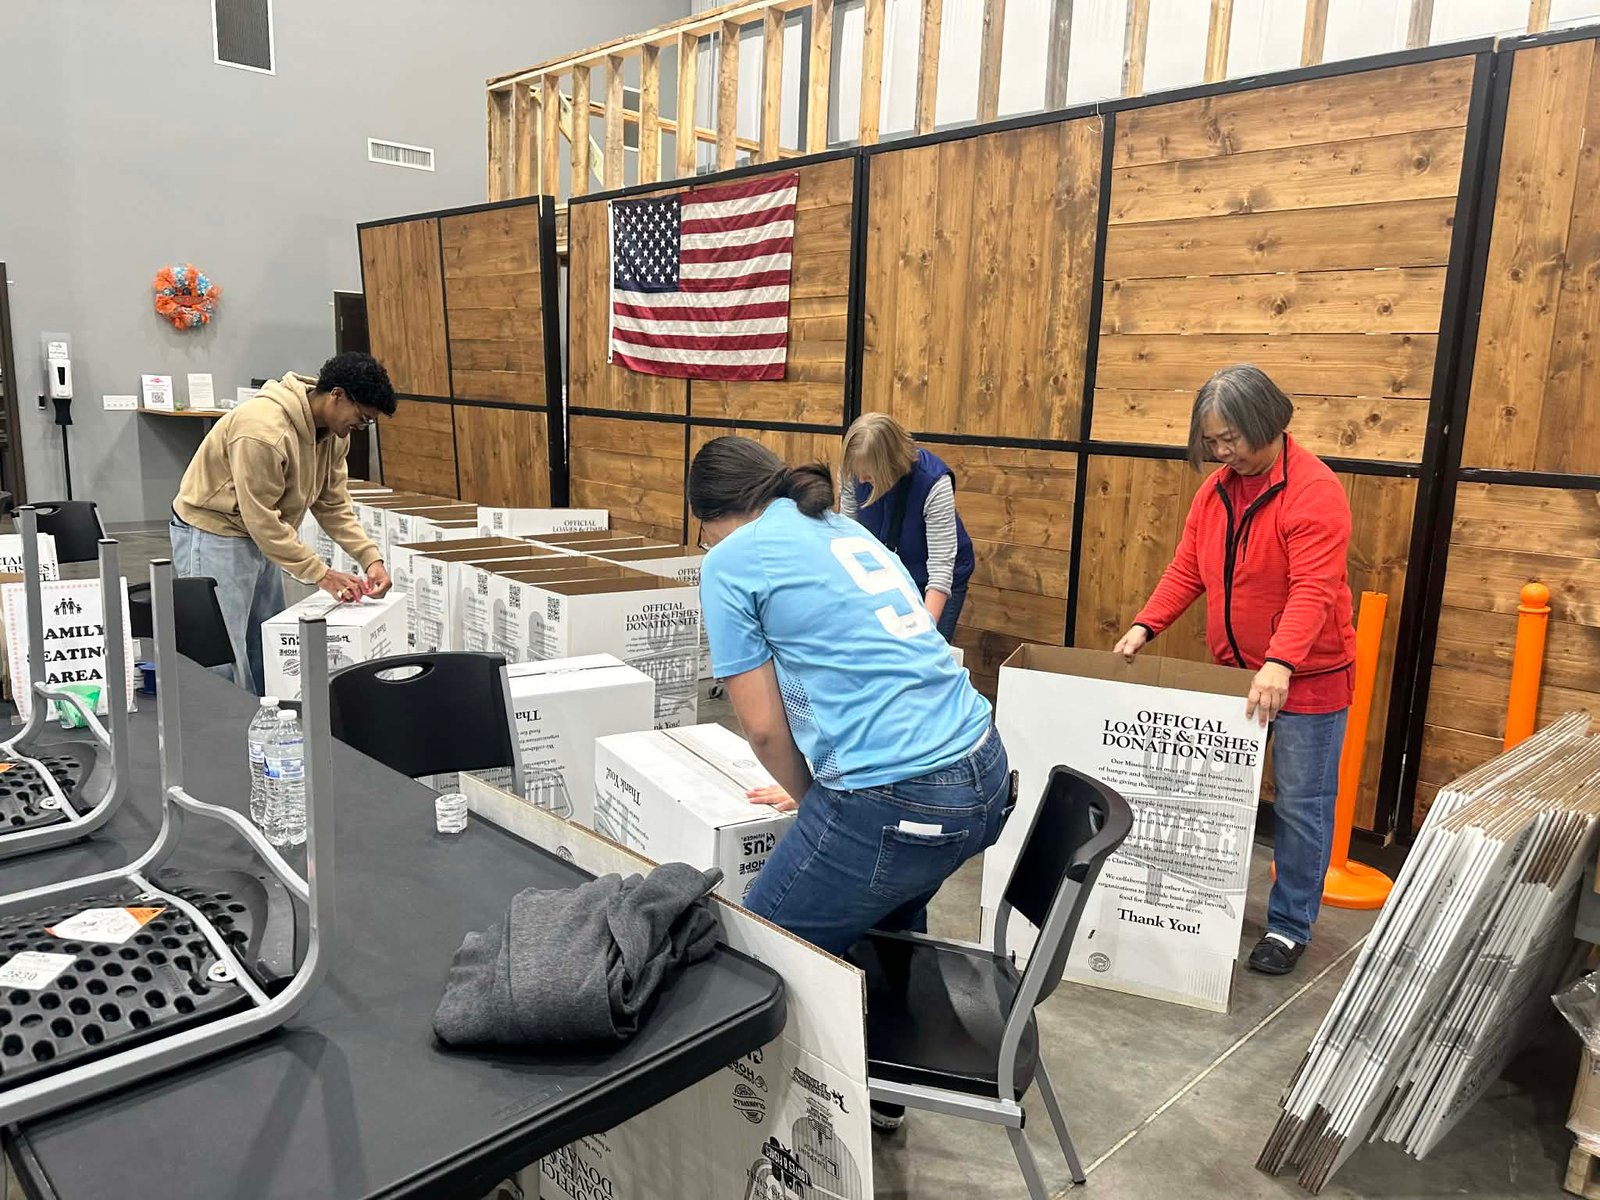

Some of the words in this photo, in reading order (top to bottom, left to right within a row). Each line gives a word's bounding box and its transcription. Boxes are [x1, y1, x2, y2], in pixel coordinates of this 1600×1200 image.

[677, 567, 701, 576] OFFIC
[830, 536, 931, 639] 9
[626, 612, 660, 623] LOAVES
[661, 612, 670, 620] &
[671, 608, 699, 619] FISHES
[642, 602, 685, 613] OFFICIAL
[44, 624, 104, 641] AMILY
[625, 618, 678, 632] DONATION
[678, 616, 699, 626] SITE
[28, 646, 107, 663] EATIN
[46, 668, 104, 685] AREA
[515, 710, 541, 722] Tha
[1136, 710, 1228, 735] OFFICIAL
[1103, 719, 1172, 740] LOAVES
[1175, 730, 1192, 744] &
[1197, 732, 1259, 753] FISHES
[1102, 733, 1209, 761] DONATION
[1213, 749, 1257, 767] SITE
[1110, 758, 1124, 766] Our
[619, 779, 641, 807] Thank
[1118, 778, 1137, 788] giving
[1181, 788, 1197, 797] hope
[738, 859, 766, 871] HOPE
[1105, 872, 1116, 880] We
[1182, 886, 1197, 895] local
[1118, 893, 1133, 901] food
[1204, 899, 1228, 909] beyond
[1117, 907, 1165, 929] Thank
[1168, 917, 1201, 935] You!
[541, 1158, 588, 1200] OFFICI
